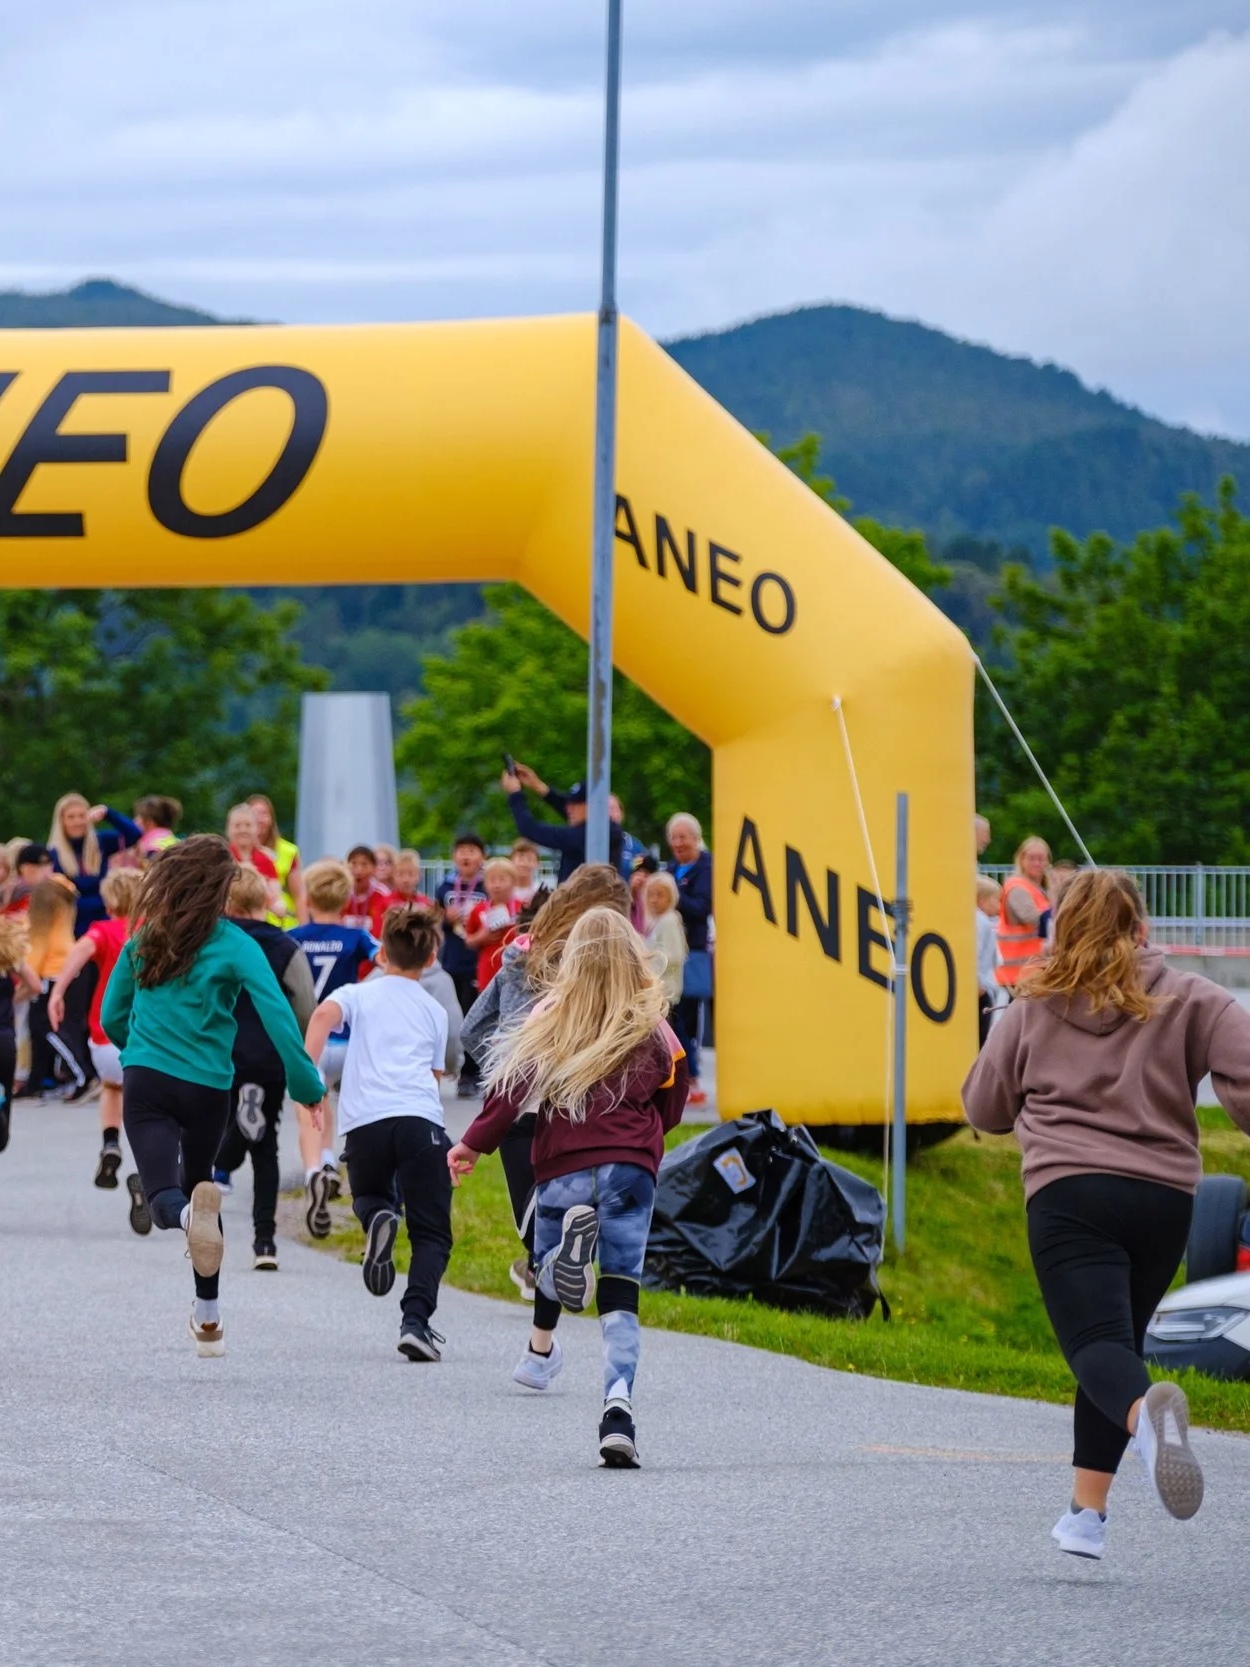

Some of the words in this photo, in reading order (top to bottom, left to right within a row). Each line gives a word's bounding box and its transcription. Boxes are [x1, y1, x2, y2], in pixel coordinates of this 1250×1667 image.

[614, 493, 796, 635] ANEO
[313, 955, 338, 1001] 7
[731, 815, 957, 1024] ANEO
